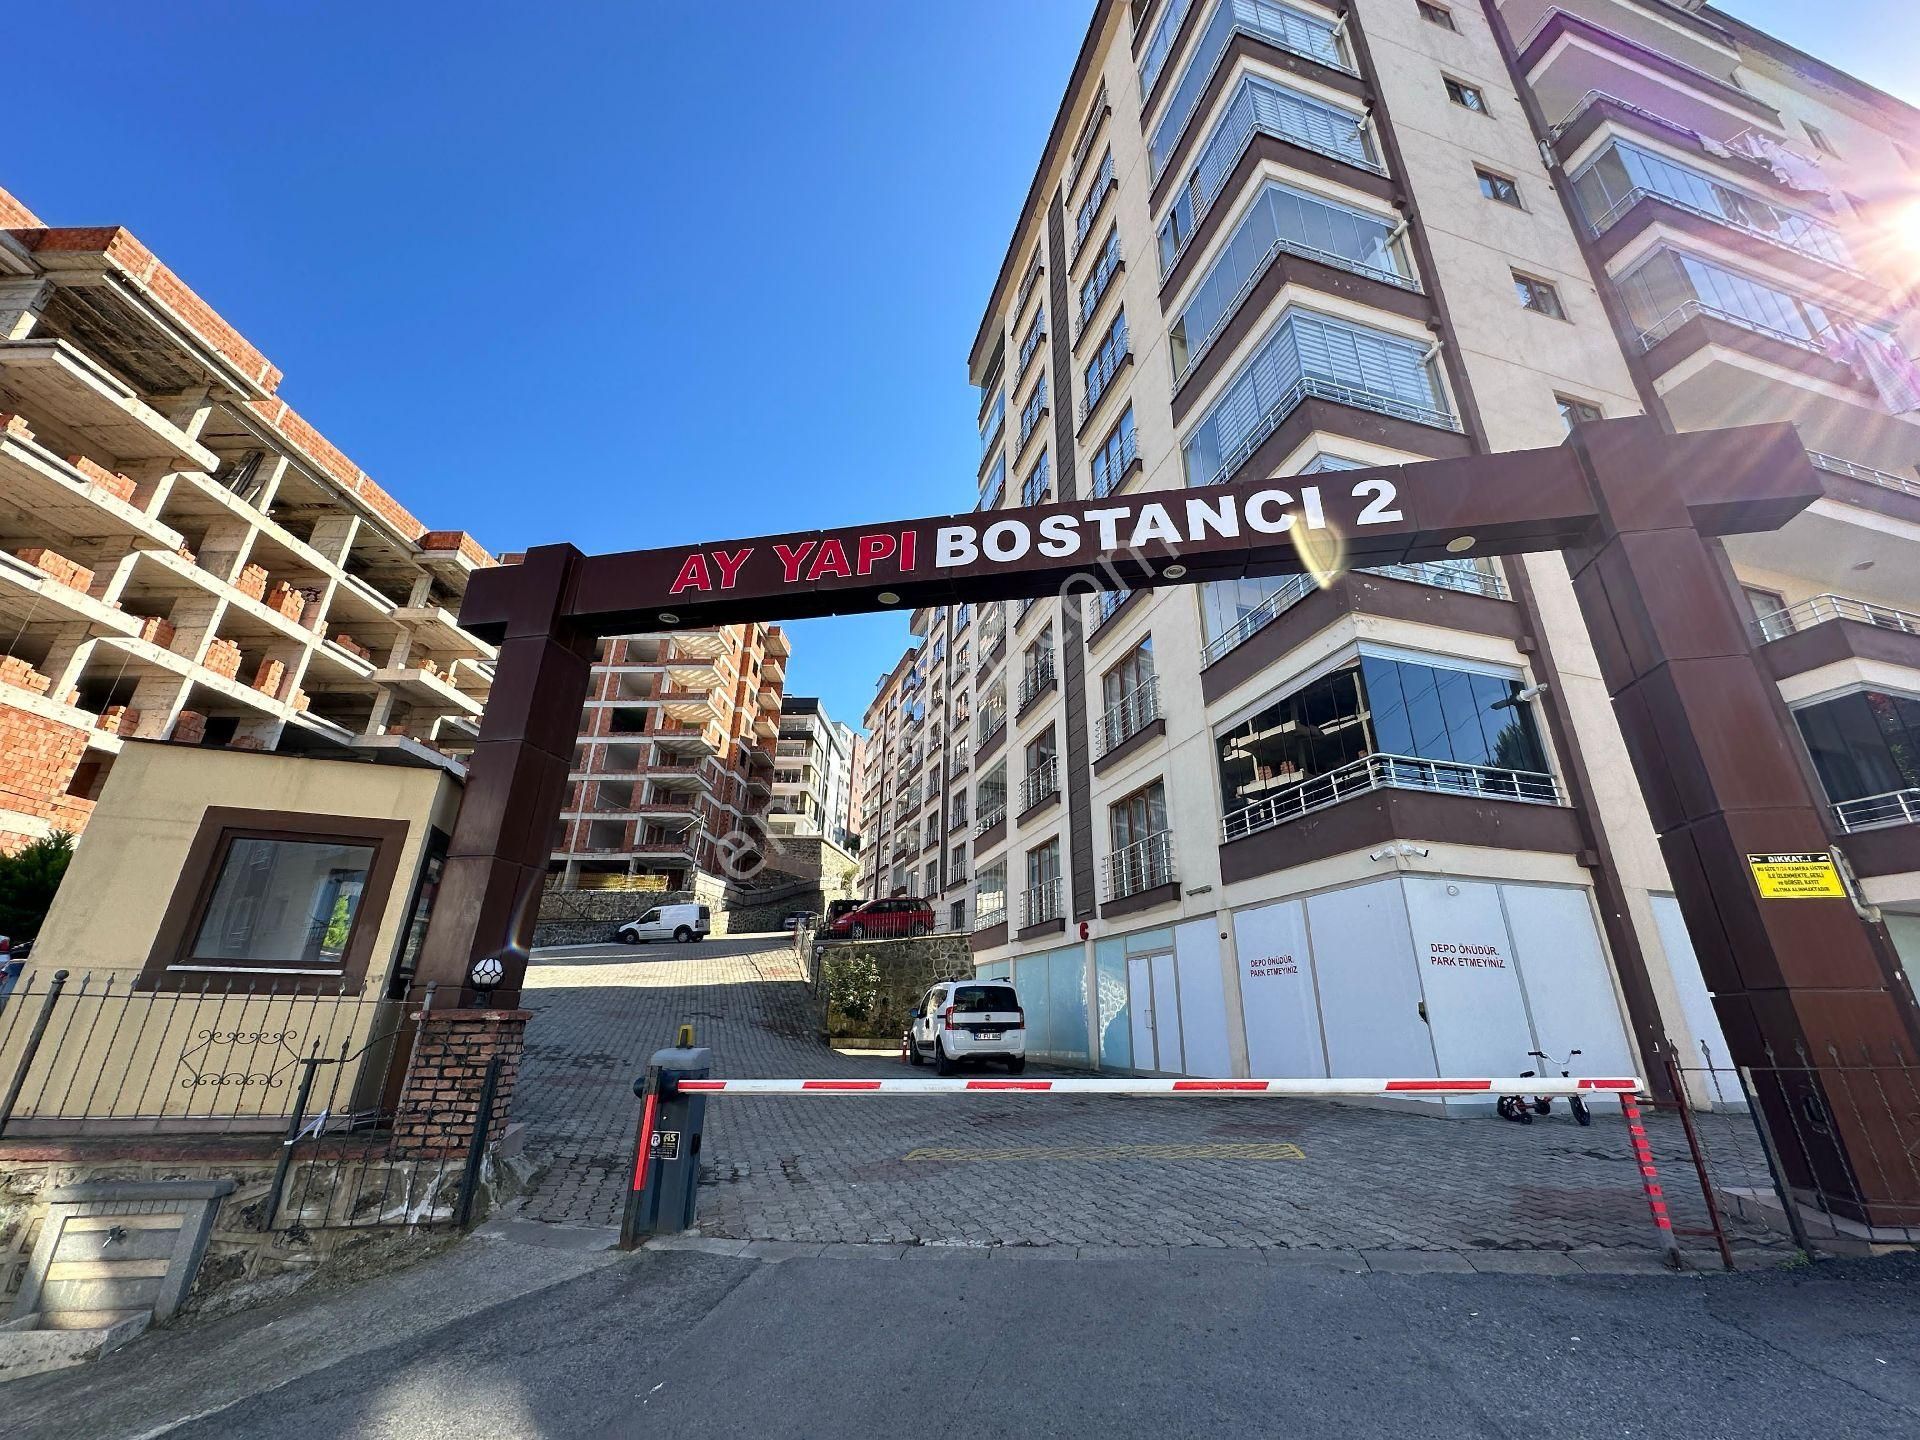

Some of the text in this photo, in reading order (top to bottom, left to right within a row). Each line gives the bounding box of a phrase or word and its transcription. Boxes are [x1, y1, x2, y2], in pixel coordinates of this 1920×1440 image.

[669, 479, 1403, 594] AY YAPI BOSTANCI 2
[1080, 922, 1089, 941] C
[1430, 942, 1500, 956] DEPO ÖNÜDÜR.
[1250, 958, 1267, 968] DEPO
[1430, 956, 1506, 969] PARK ETMEYİNİZ
[1250, 968, 1266, 978] PARK
